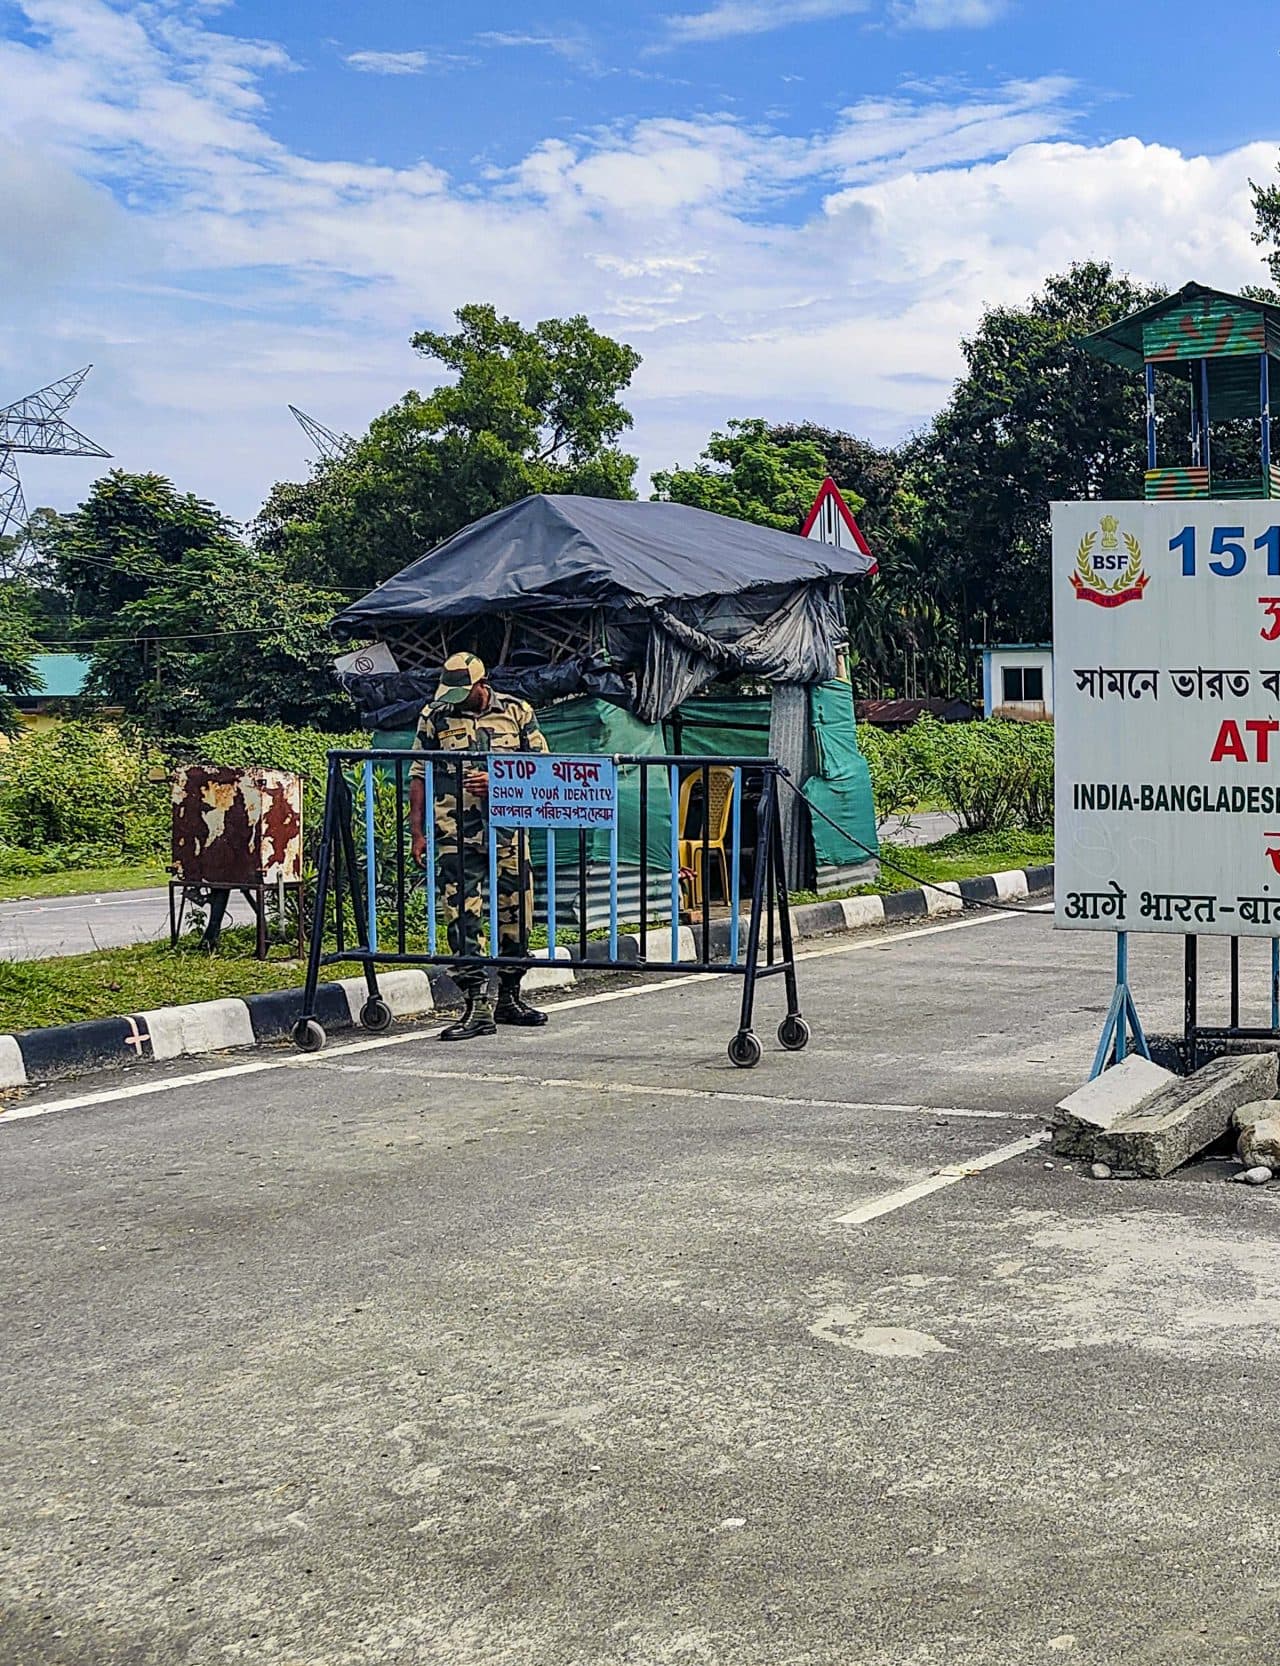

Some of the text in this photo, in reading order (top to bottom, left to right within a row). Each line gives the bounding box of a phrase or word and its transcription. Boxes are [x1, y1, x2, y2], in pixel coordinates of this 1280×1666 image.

[1093, 555, 1128, 570] BSF
[1169, 524, 1280, 577] 151
[1073, 665, 1160, 701] সামনে
[1169, 665, 1250, 701] ভারত
[492, 760, 601, 787] STOP থামুন
[493, 786, 523, 799] SHOW
[531, 786, 559, 800] YOUR
[490, 805, 534, 819] আপনার
[1064, 881, 1127, 920] आगे
